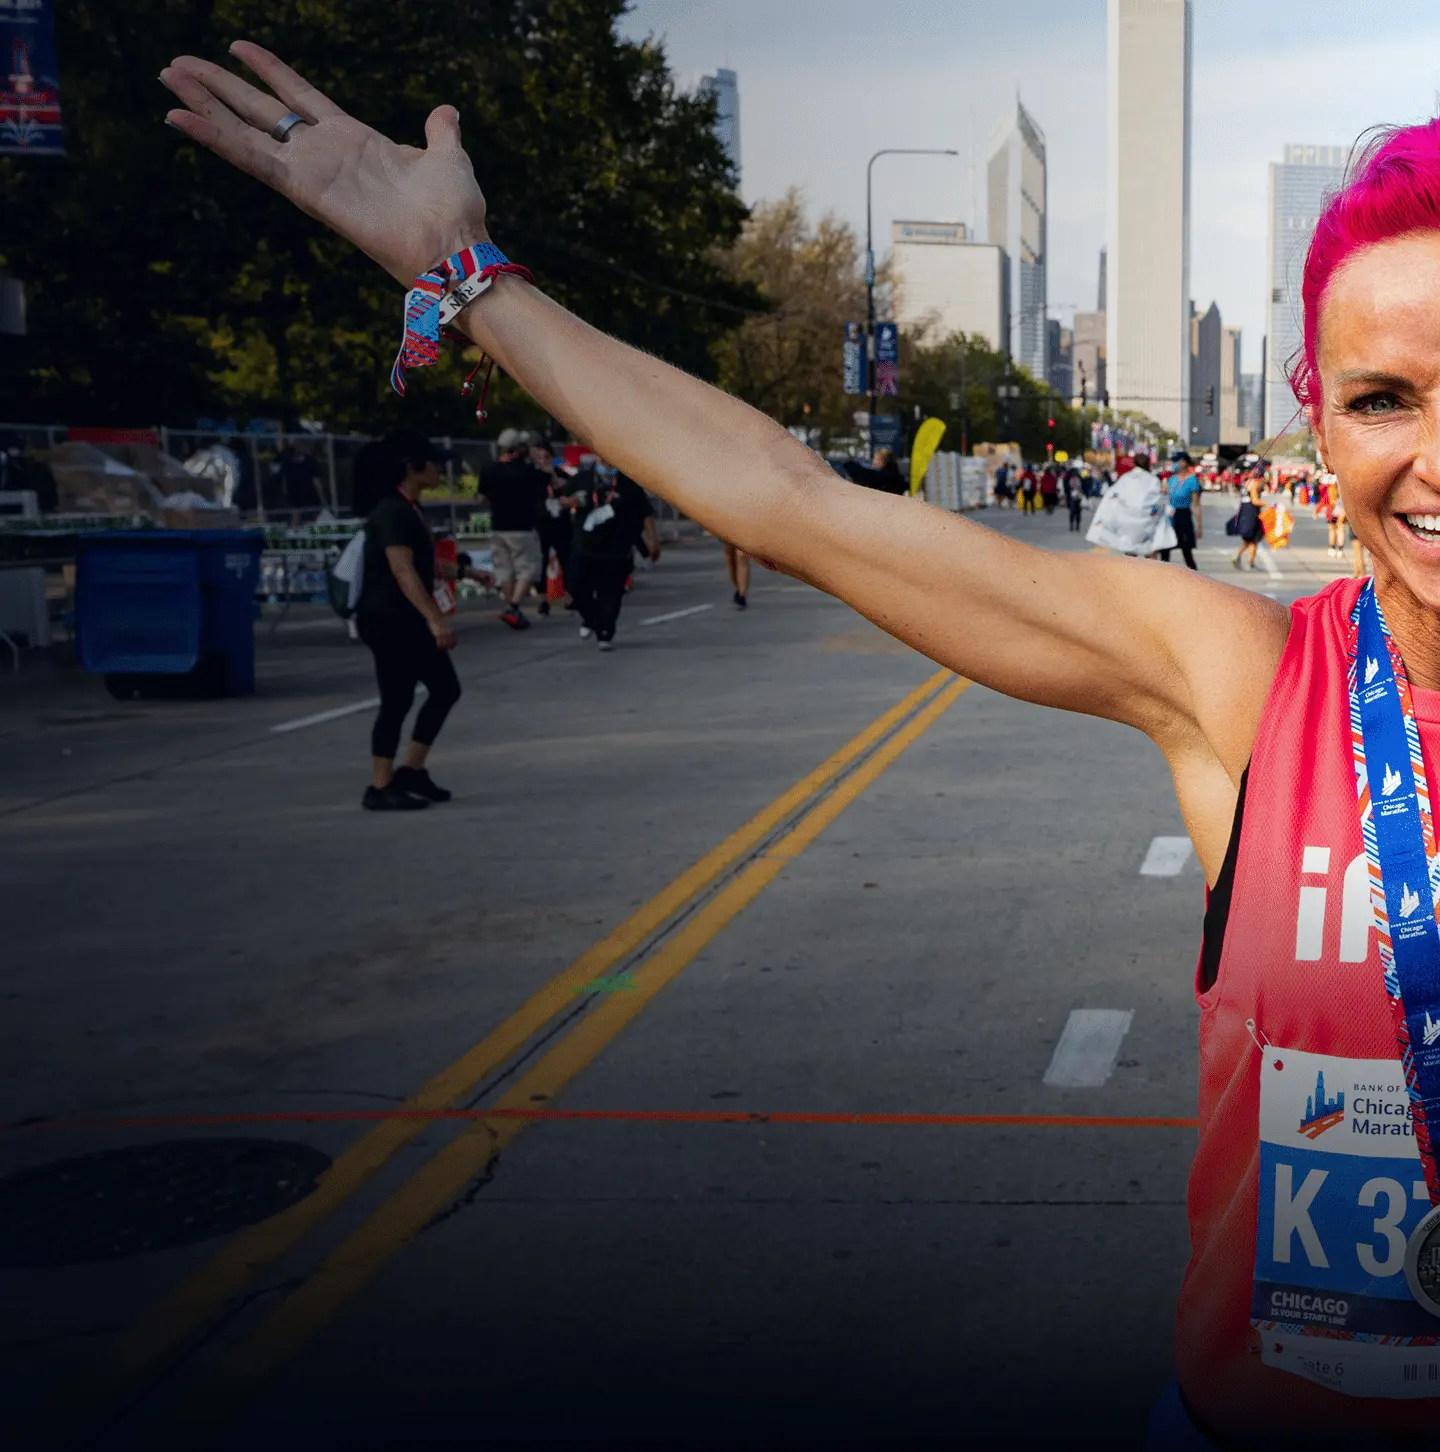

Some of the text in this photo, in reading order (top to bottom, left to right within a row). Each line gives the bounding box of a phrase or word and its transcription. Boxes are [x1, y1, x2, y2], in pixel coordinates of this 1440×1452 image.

[1380, 807, 1409, 816] Marathon
[1382, 802, 1406, 811] Chicago
[1399, 930, 1427, 940] Marathon
[1400, 925, 1424, 933] Chicago
[1353, 1084, 1383, 1092] BANK
[1353, 1098, 1414, 1120] Chicag
[1352, 1118, 1414, 1136] Marat
[1273, 1163, 1331, 1269] K
[1271, 1290, 1348, 1315] CHICAGO
[1270, 1308, 1347, 1326] IS YOUR START LINE
[1335, 1362, 1345, 1375] 6
